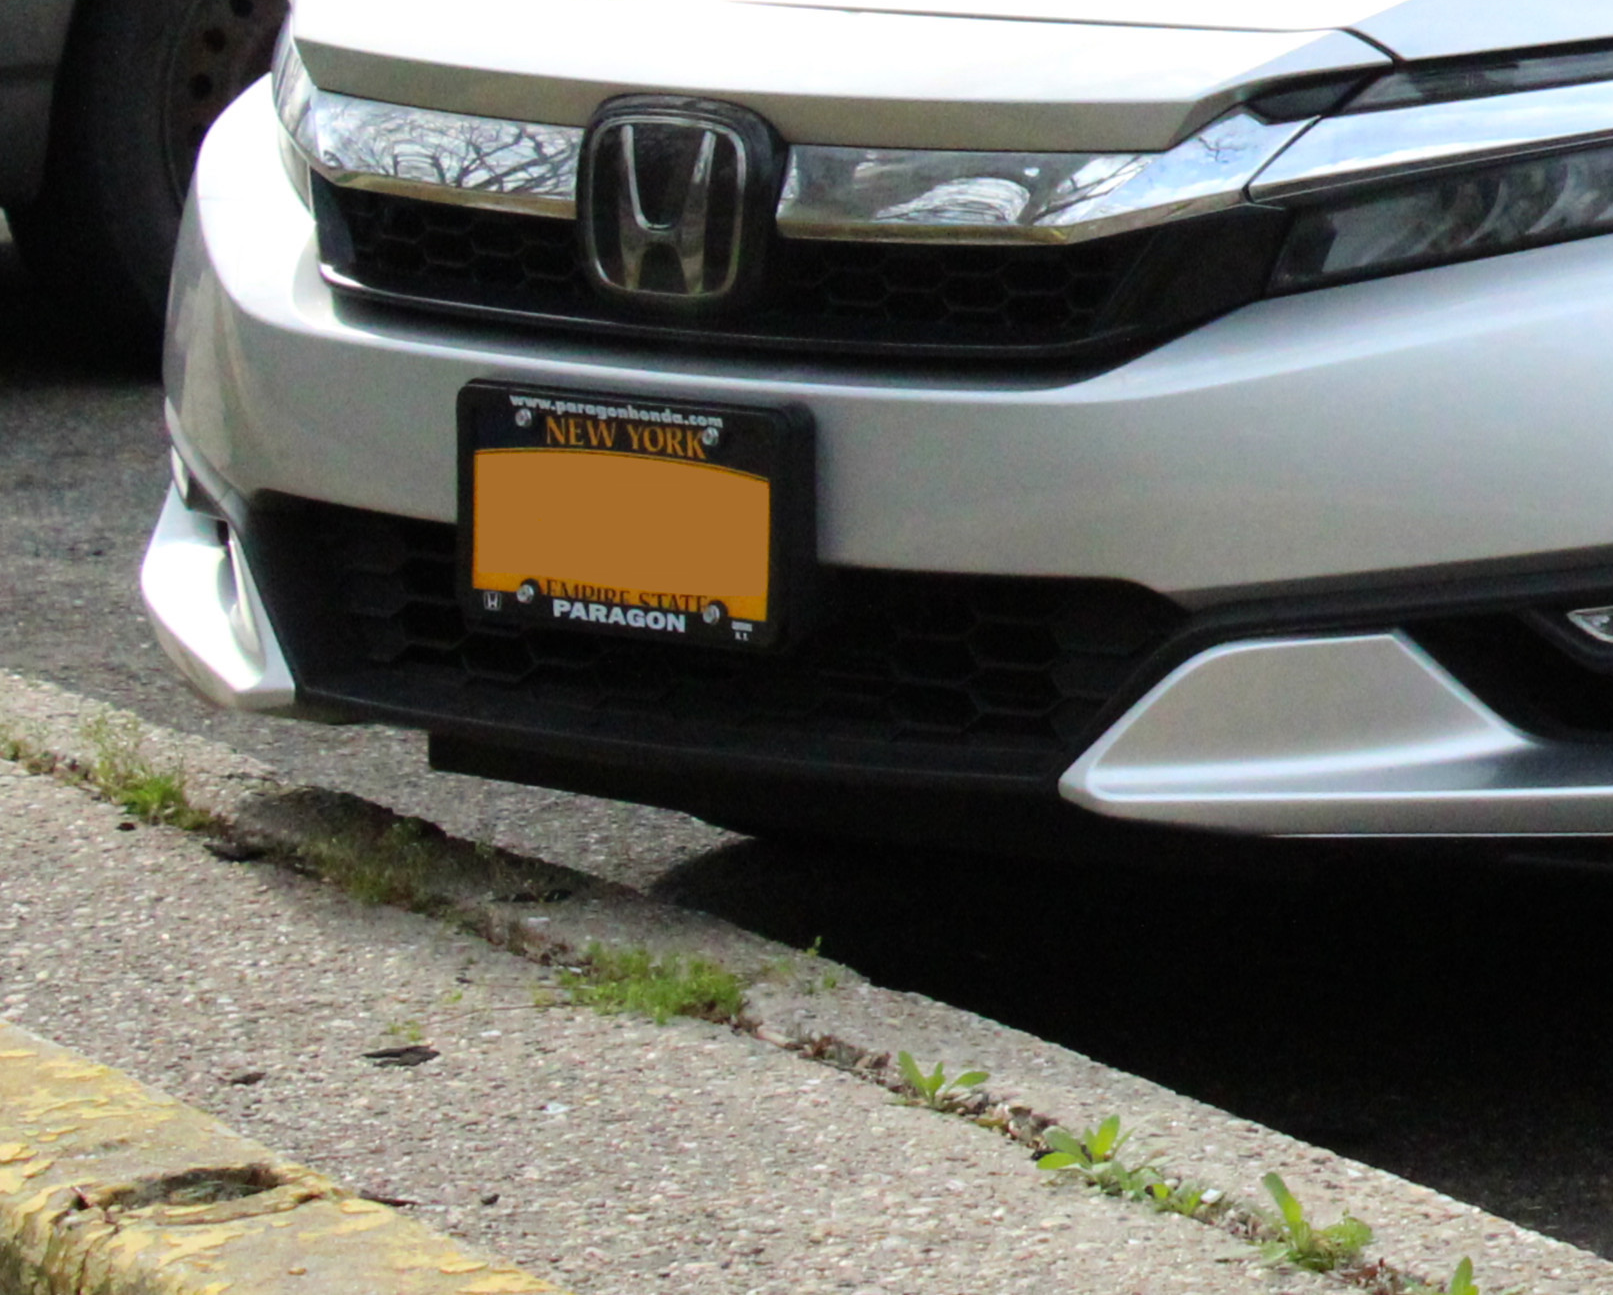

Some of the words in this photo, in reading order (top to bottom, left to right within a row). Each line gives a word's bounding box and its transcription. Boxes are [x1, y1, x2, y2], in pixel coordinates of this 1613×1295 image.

[509, 394, 723, 428] www.paragonhonda.com
[545, 416, 616, 448] NEW
[626, 423, 707, 459] YORK
[552, 599, 686, 633] PARAGON
